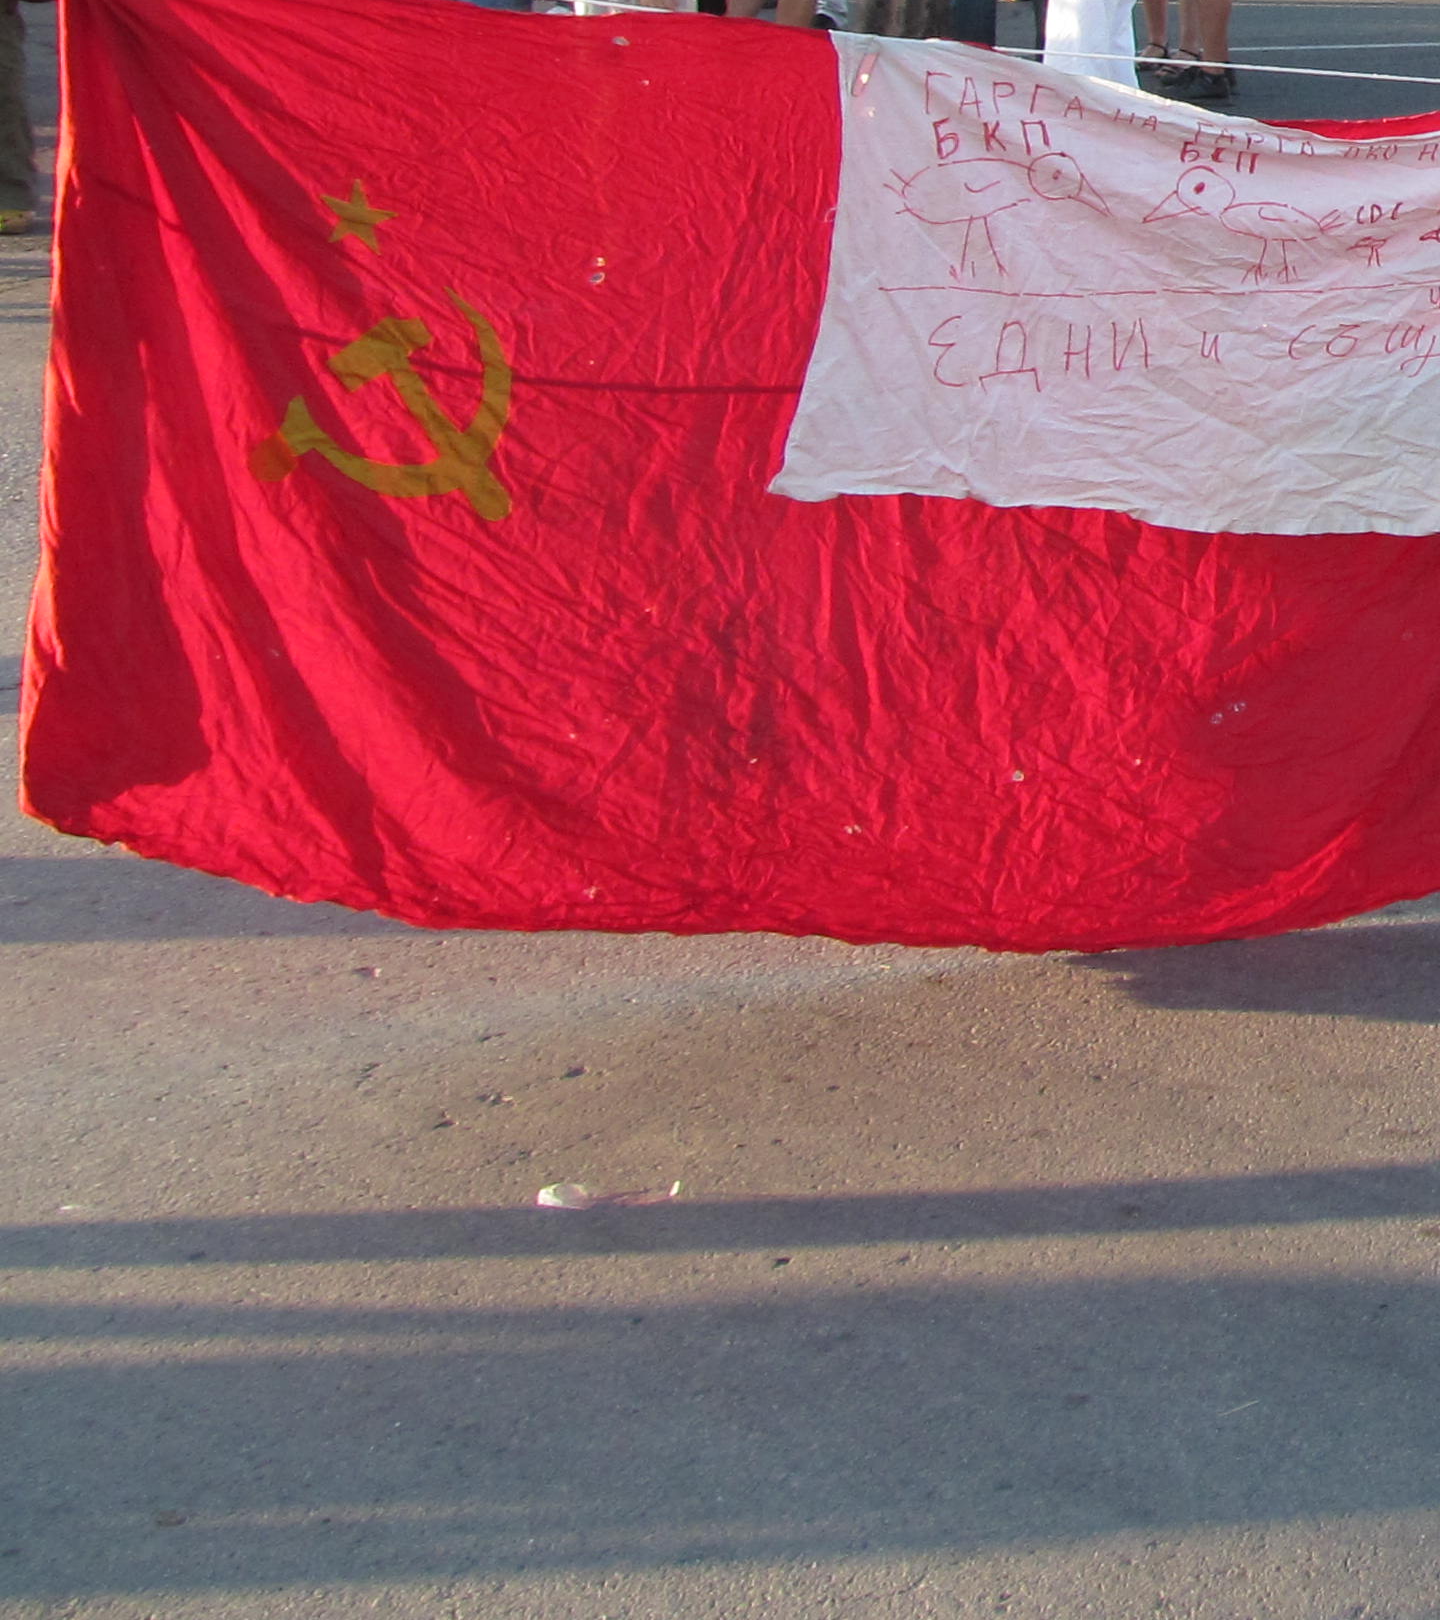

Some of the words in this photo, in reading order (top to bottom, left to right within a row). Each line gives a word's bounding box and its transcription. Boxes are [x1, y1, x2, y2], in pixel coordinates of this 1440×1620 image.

[925, 70, 1085, 120] ГАРГА
[932, 117, 1052, 159] БКП
[1179, 140, 1260, 174] БСП
[926, 314, 1151, 395] ЕДНИ
